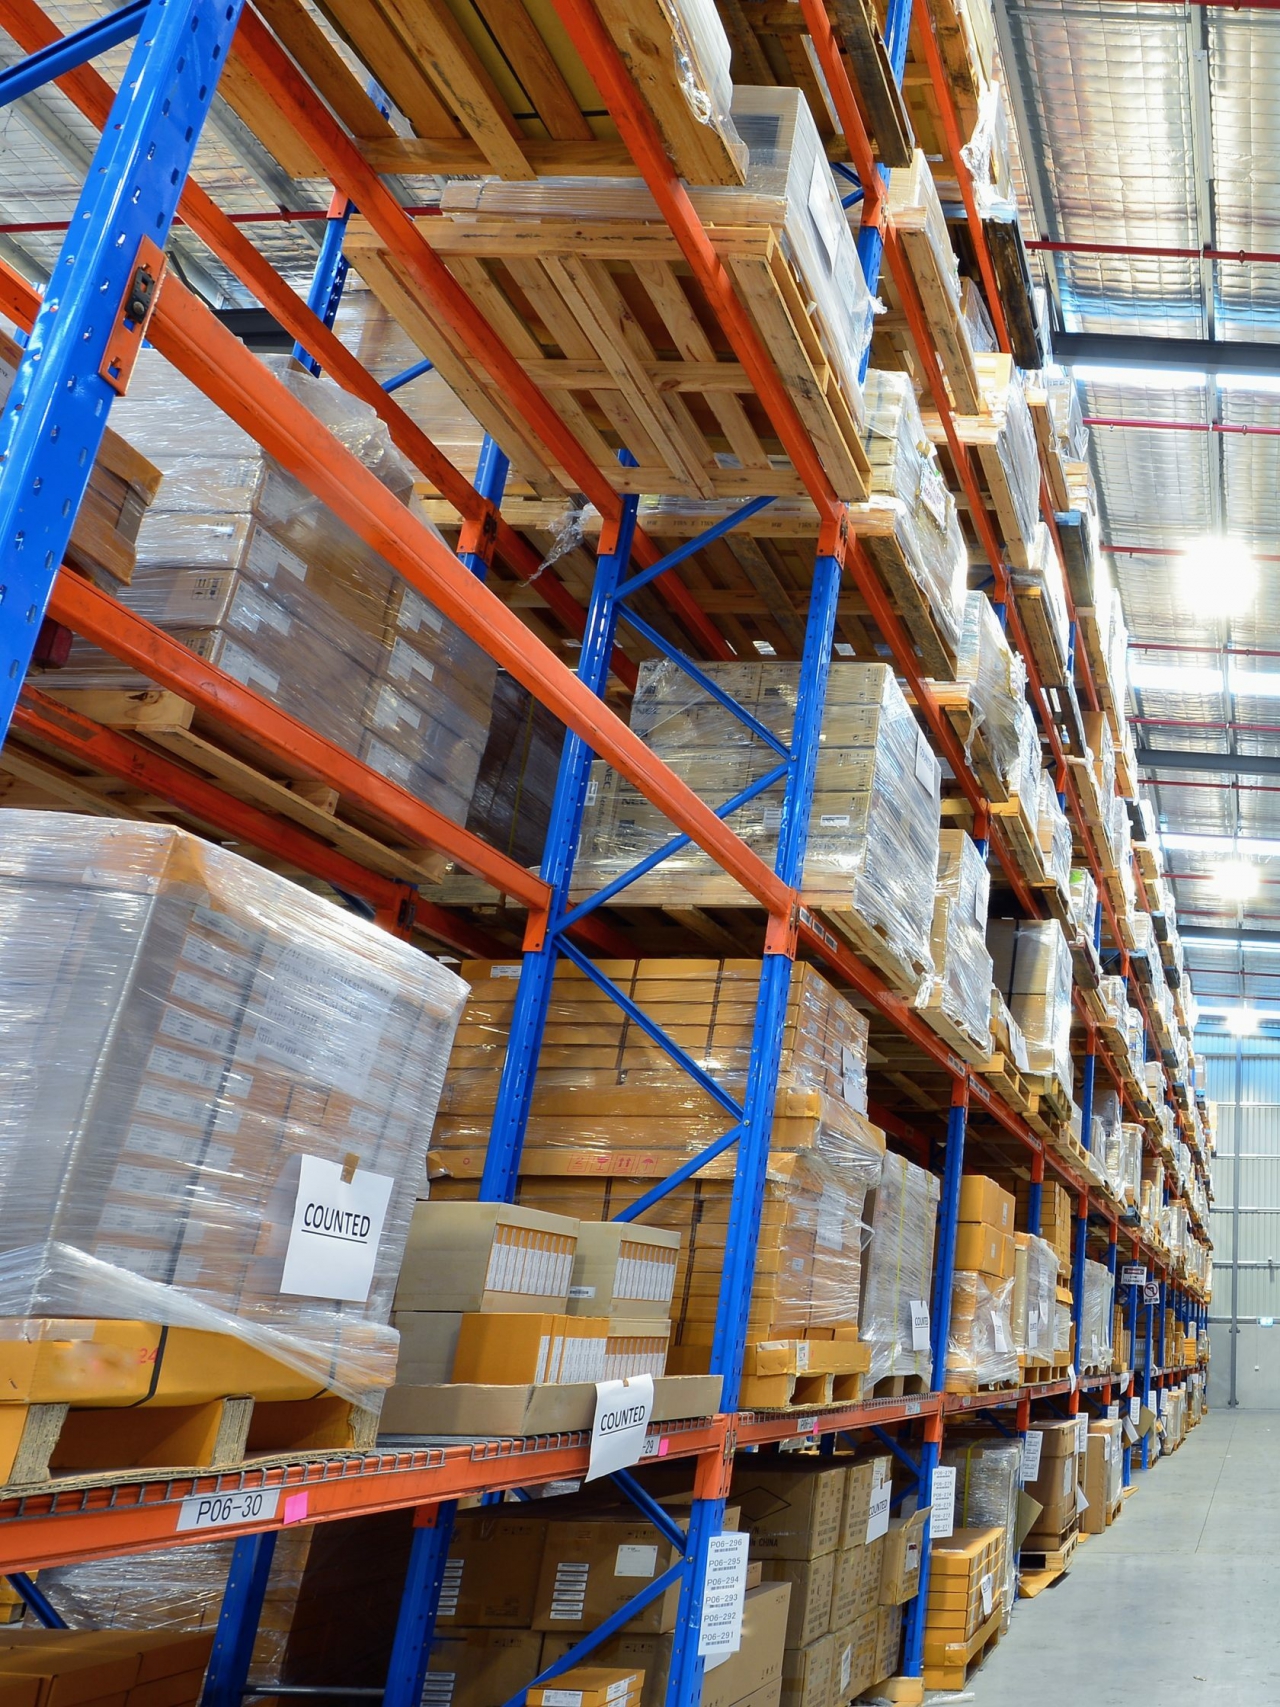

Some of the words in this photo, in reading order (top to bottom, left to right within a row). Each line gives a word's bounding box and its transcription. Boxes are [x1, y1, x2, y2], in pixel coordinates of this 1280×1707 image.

[304, 1203, 371, 1237] COUNTED
[601, 1405, 646, 1431] COUNTED
[868, 1499, 888, 1516] COUNTED
[710, 1539, 742, 1549] P06-296
[759, 1538, 778, 1547] CHINA
[709, 1558, 741, 1568] P06-295
[707, 1576, 739, 1586] P06-294
[705, 1594, 738, 1605] P06-293
[704, 1612, 736, 1623] P06-292
[702, 1631, 734, 1641] P06-291
